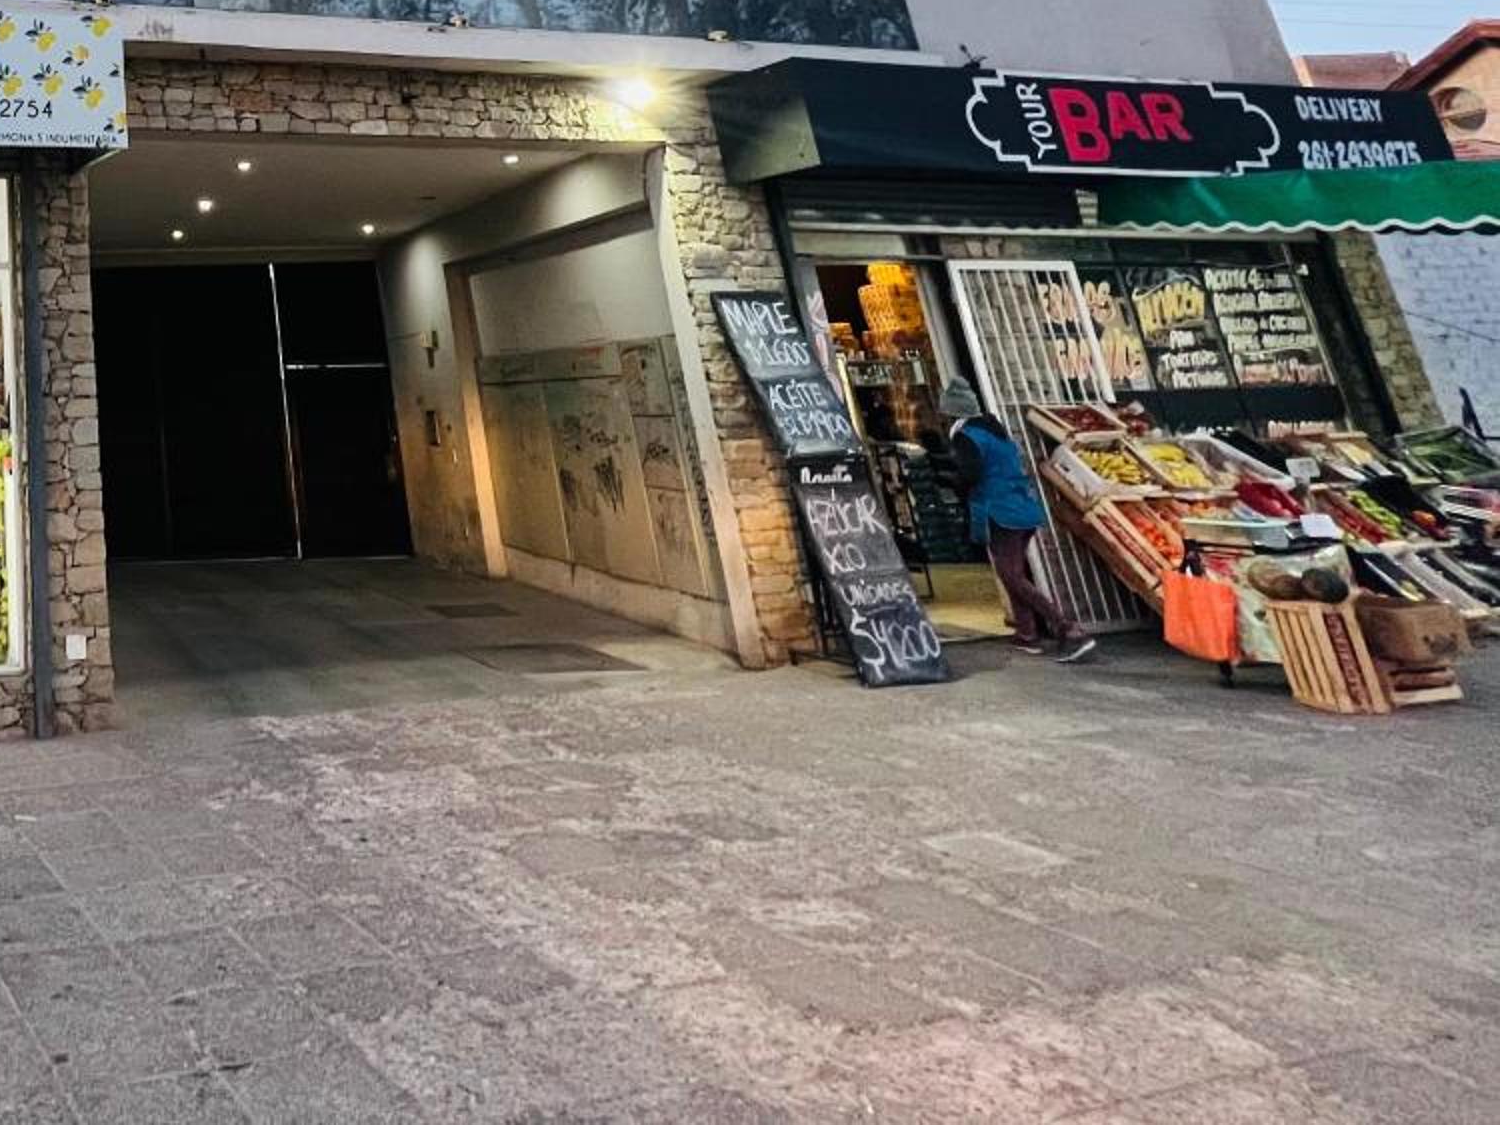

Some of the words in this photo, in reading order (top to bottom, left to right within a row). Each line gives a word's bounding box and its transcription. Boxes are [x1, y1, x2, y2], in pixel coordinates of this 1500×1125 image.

[0, 98, 53, 119] 2754
[1015, 81, 1057, 160] YOUR
[1048, 87, 1194, 162] BAR
[1294, 94, 1382, 123] DELIVERY
